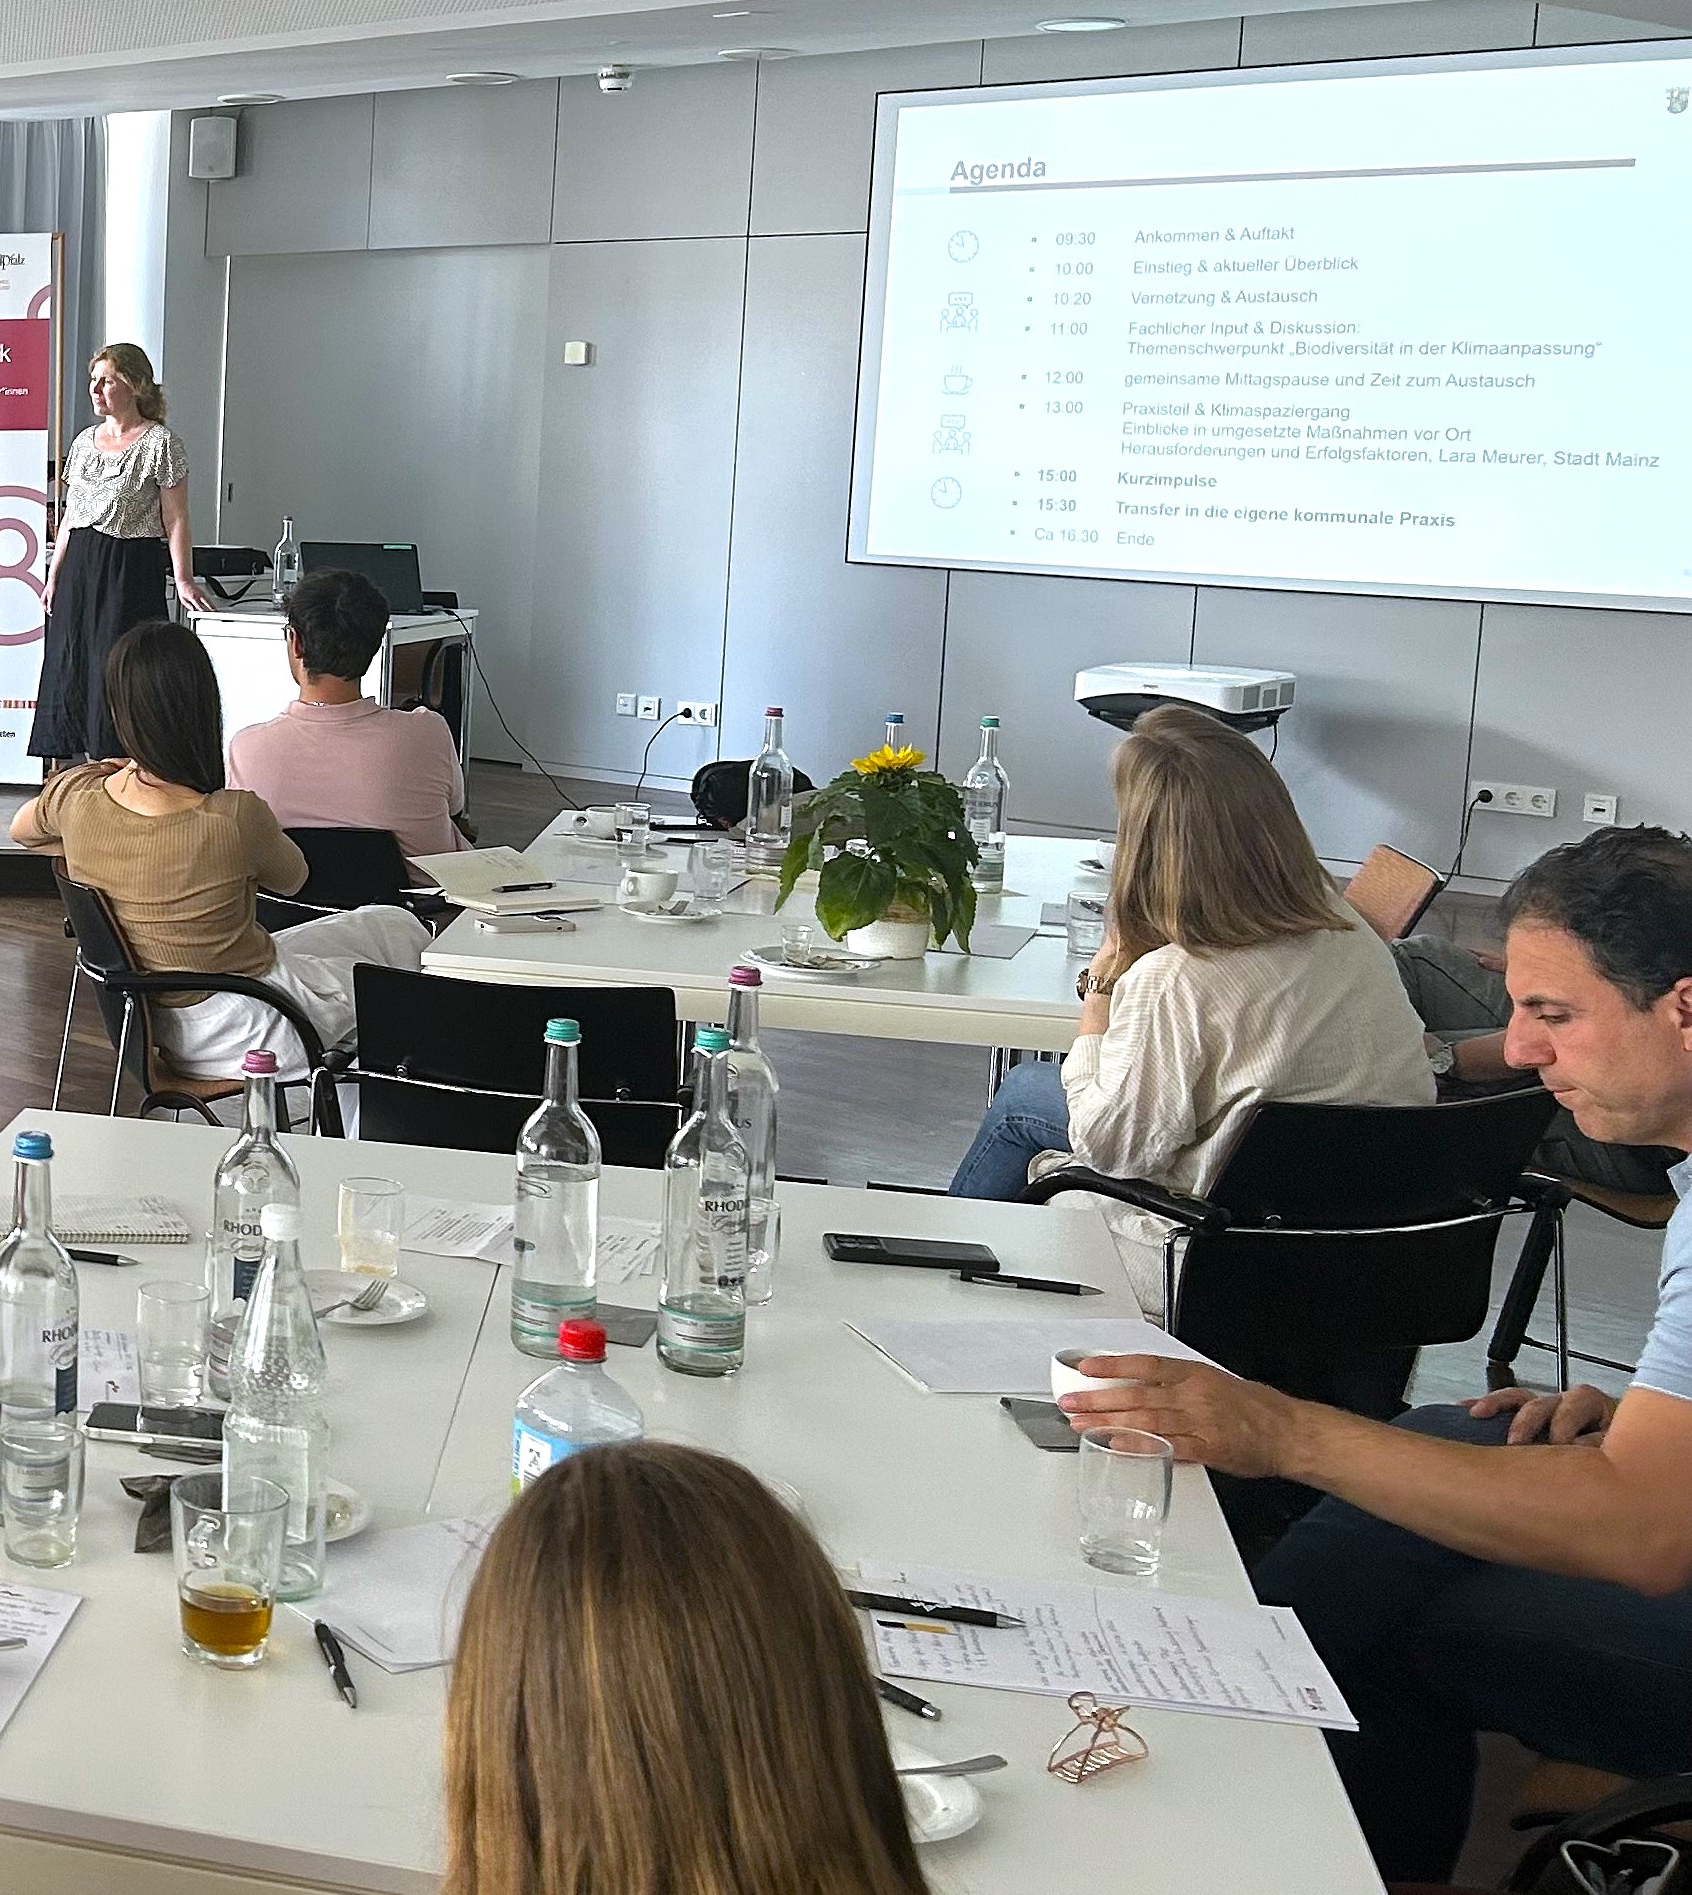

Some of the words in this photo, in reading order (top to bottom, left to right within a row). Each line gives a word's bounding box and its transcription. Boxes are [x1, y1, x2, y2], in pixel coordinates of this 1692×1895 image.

[950, 156, 1046, 186] Agenda
[1134, 229, 1220, 244] Ankommen
[1224, 227, 1236, 242] &
[1239, 226, 1295, 241] Auftakt
[1133, 260, 1192, 277] Einstieg
[1197, 259, 1209, 273] &
[1213, 258, 1280, 273] aktueller
[1284, 255, 1359, 272] Überblick
[1131, 290, 1216, 307] Vernetzung
[1220, 290, 1232, 304] &
[1234, 289, 1318, 304] Austausch
[1128, 321, 1206, 336] Fachlicher
[1210, 321, 1249, 338] Input
[1252, 320, 1265, 335] &
[1269, 320, 1362, 336] Diskussion:
[1127, 341, 1285, 358] Themenschwerpunkt
[1399, 340, 1413, 356] in
[1418, 341, 1447, 356] der
[1045, 370, 1084, 385] 12:00
[1124, 373, 1221, 390] gemeinsame
[1225, 372, 1330, 389] Mittagspause
[1334, 372, 1366, 387] und
[1369, 372, 1401, 387] Zeit
[1405, 376, 1441, 388] zum
[1445, 372, 1536, 388] Austausch
[1045, 400, 1084, 414] 13:00
[1122, 401, 1190, 416] Praxisteil
[1194, 402, 1206, 416] &
[1210, 402, 1351, 422] Klimaspaziergang
[1122, 421, 1189, 436] Einblicke
[1193, 421, 1208, 437] in
[1211, 424, 1302, 441] umgesetzte
[1306, 424, 1408, 441] Maßnahmen
[1413, 429, 1441, 441] vor
[1444, 427, 1472, 442] Ort
[1121, 441, 1266, 461] Herausforderungen
[1271, 445, 1300, 460] und
[1305, 445, 1433, 464] Erfolgsfaktoren,
[1438, 448, 1476, 464] Lara
[1482, 448, 1548, 468] Meurer,
[1552, 450, 1600, 467] Stadt
[1605, 451, 1660, 468] Mainz
[1037, 468, 1078, 483] 15:00
[1117, 471, 1218, 490] Kurzimpulse
[1037, 497, 1077, 512] 15:30
[1115, 500, 1181, 517] Transfer
[1185, 504, 1199, 518] in
[1204, 504, 1229, 519] die
[1233, 506, 1289, 523] eigene
[1293, 507, 1394, 525] kommunale
[1399, 511, 1456, 528] Praxis
[1116, 530, 1155, 546] Ende
[704, 1199, 750, 1213] RHOD
[223, 1219, 263, 1237] RHOD
